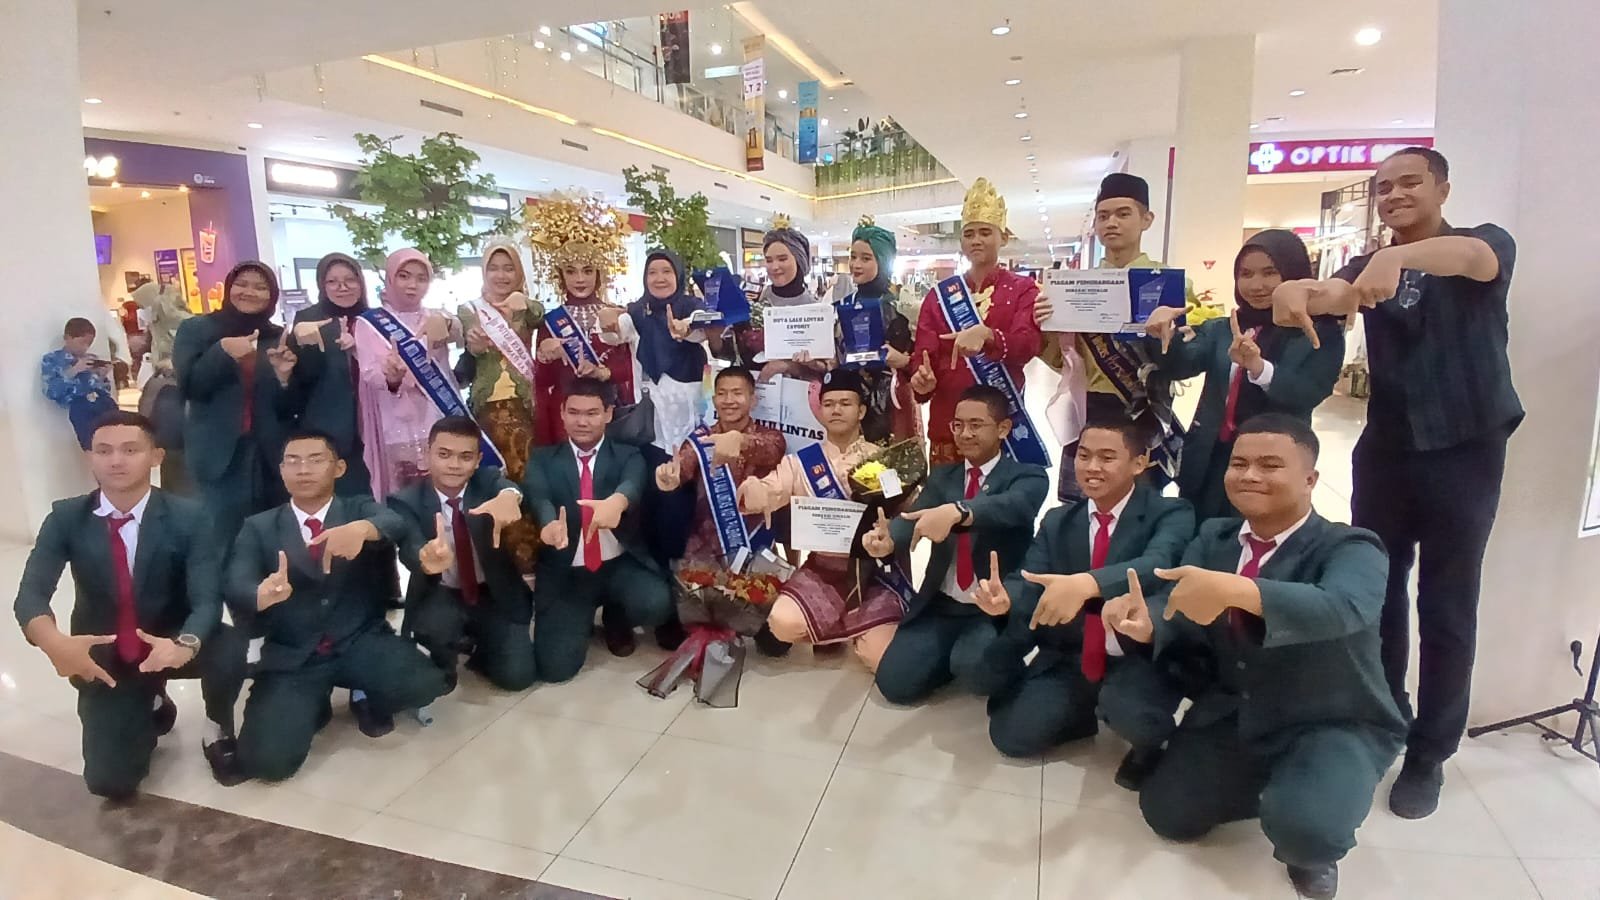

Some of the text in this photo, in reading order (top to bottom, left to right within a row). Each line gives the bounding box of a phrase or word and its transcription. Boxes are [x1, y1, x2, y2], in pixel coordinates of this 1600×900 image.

[756, 82, 762, 92] 2
[1290, 145, 1367, 166] OPTIK
[780, 424, 825, 441] LINTAS
